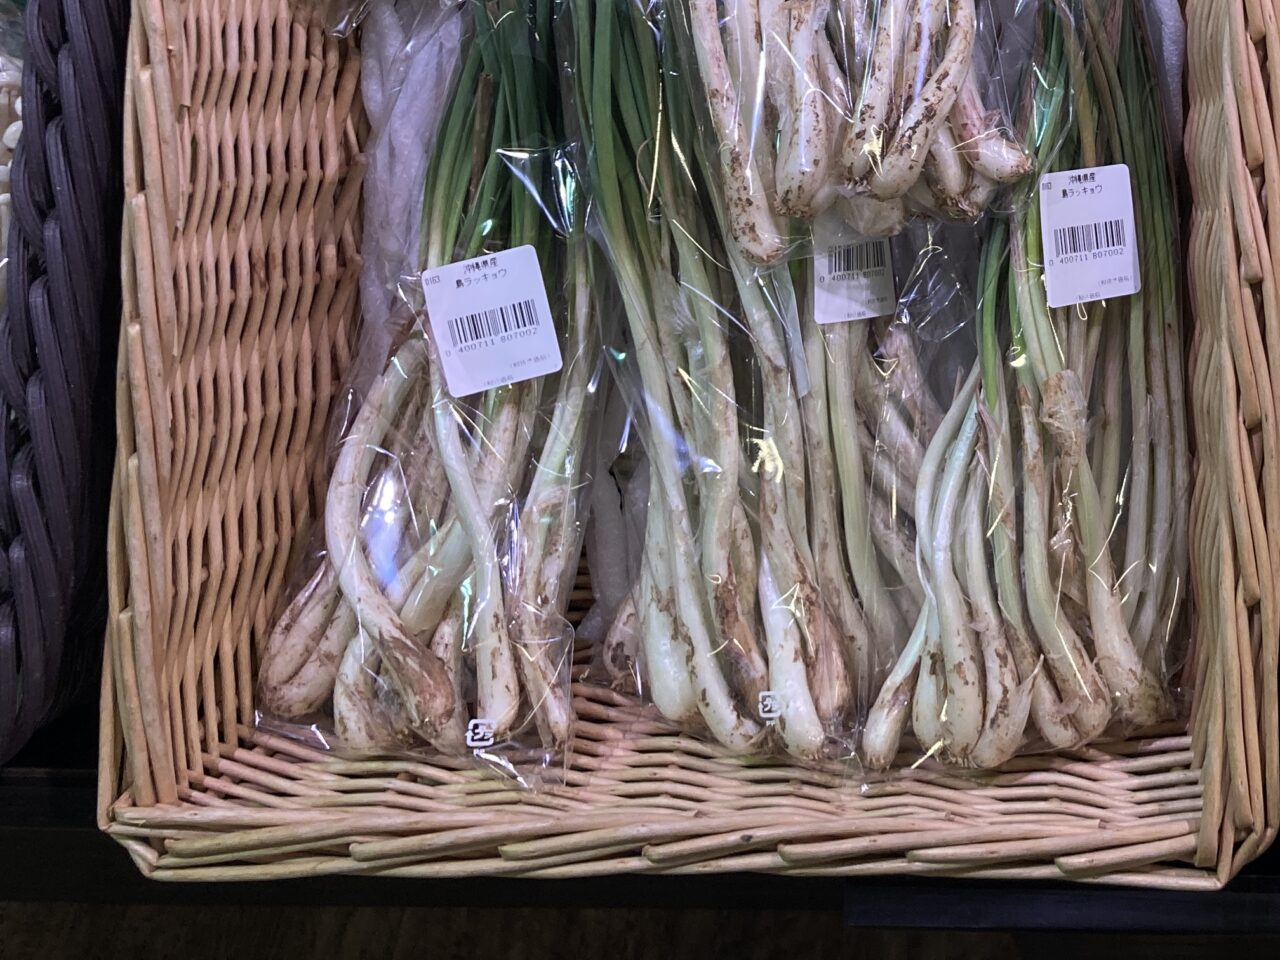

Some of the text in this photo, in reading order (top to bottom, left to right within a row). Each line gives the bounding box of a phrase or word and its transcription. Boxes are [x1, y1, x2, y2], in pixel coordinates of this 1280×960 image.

[1069, 173, 1096, 185] 沖縄県産
[1062, 185, 1103, 198] 島ラッキョウ
[1060, 255, 1088, 264] 400711
[1093, 248, 1124, 259] 807002
[464, 257, 498, 274] 沖縄県産
[425, 276, 440, 286] 0163
[456, 269, 507, 288] 島ラッキョウ
[832, 273, 859, 281] 400711
[458, 340, 495, 353] 400711
[500, 328, 537, 342] 807002
